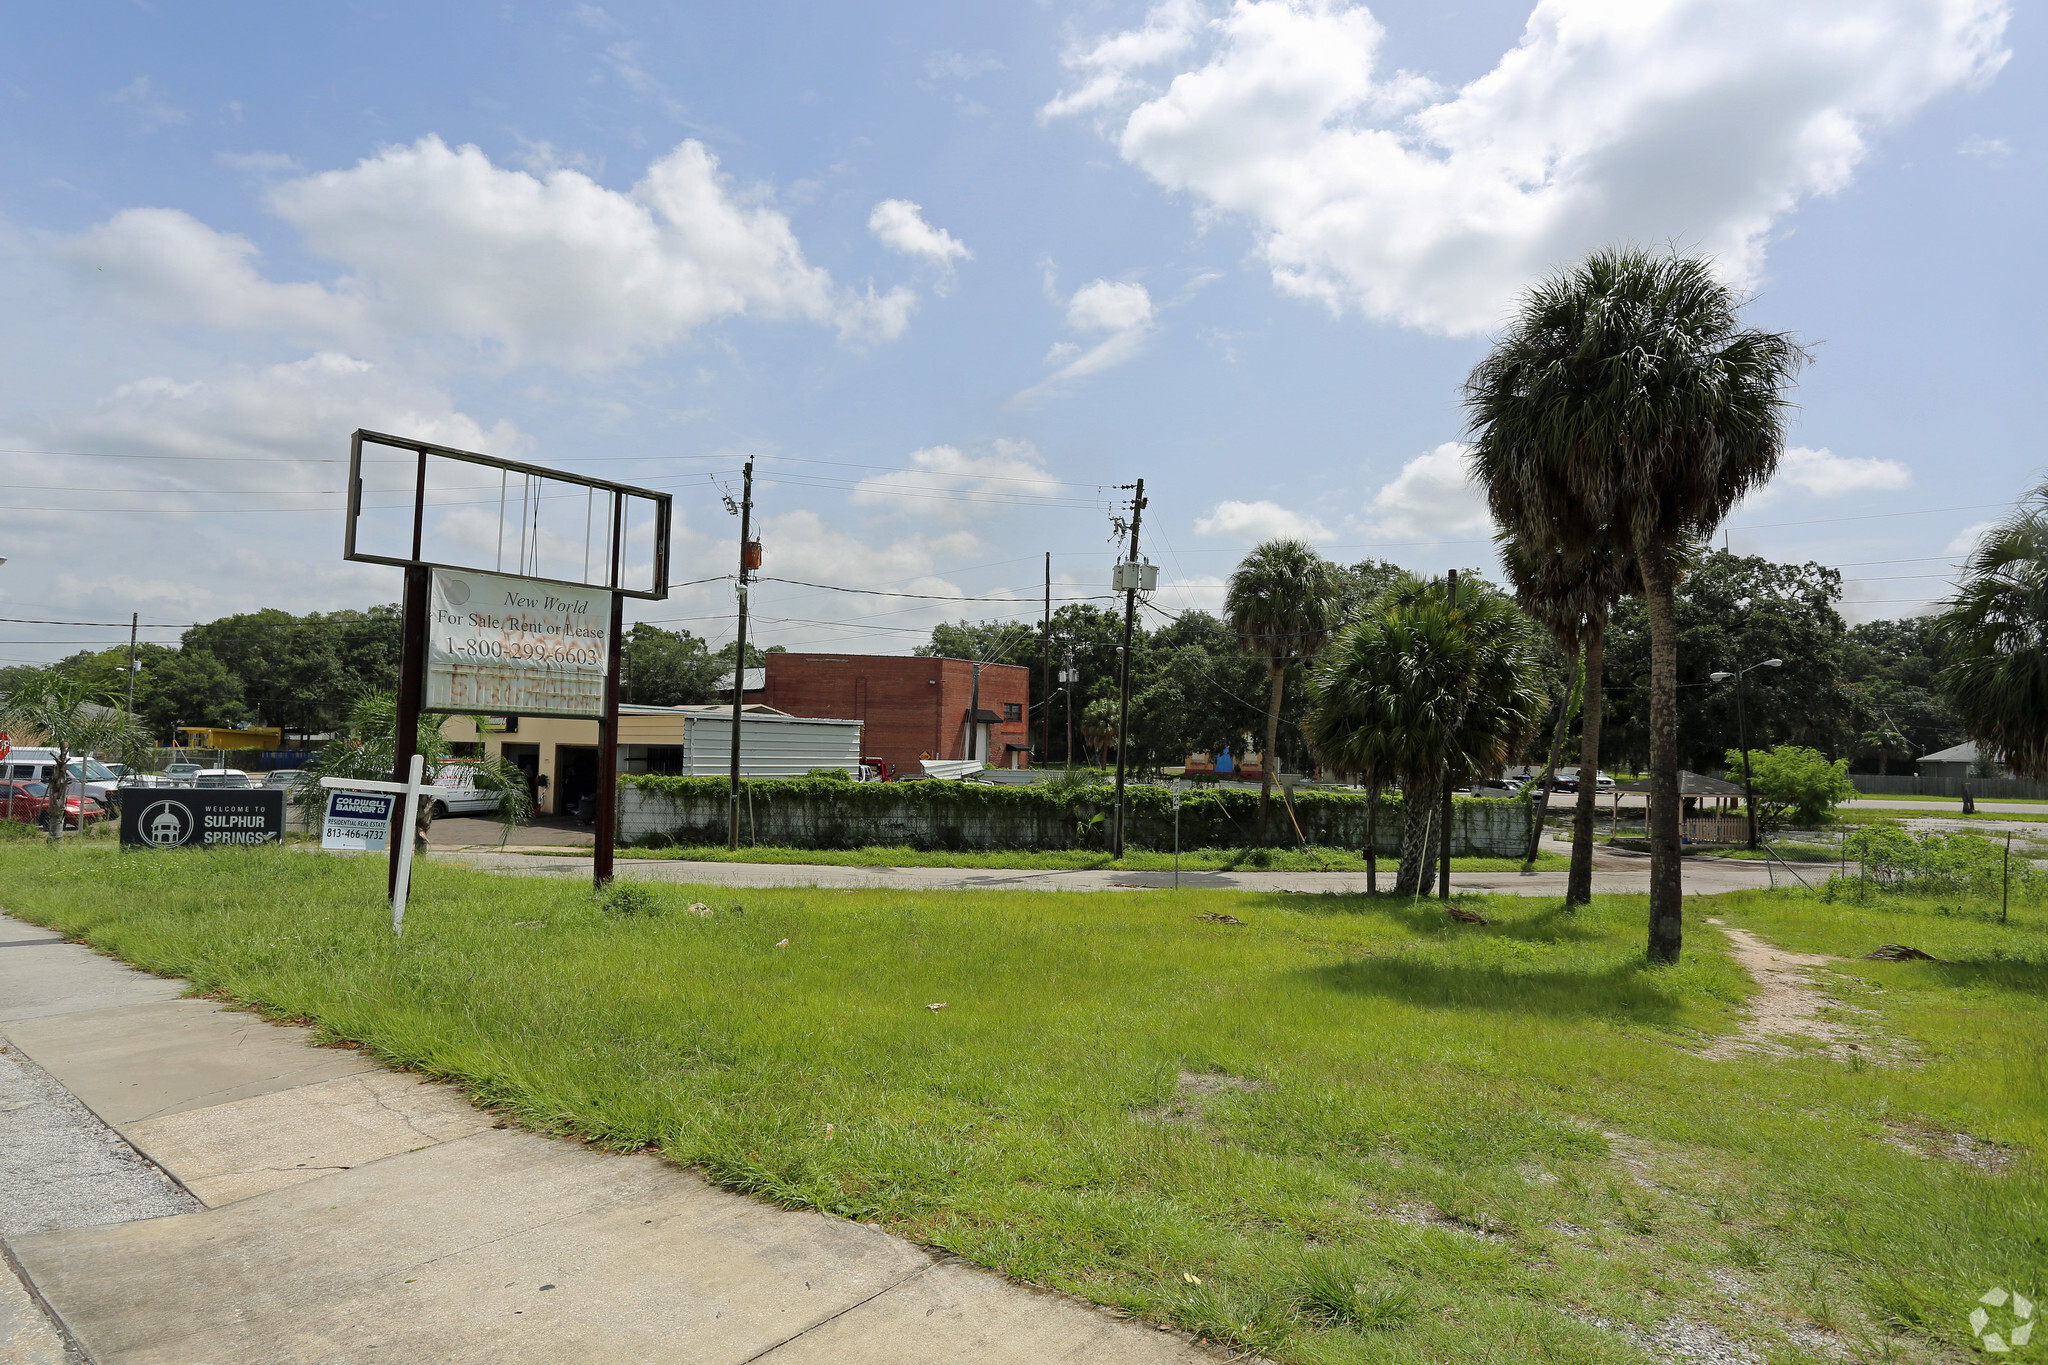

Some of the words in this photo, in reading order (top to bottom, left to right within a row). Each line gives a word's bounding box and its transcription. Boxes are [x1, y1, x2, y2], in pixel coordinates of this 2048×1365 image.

[504, 592, 538, 609] New
[544, 597, 589, 615] World
[438, 609, 463, 625] For
[469, 613, 503, 631] Sale,
[510, 618, 542, 634] Rent
[547, 624, 562, 635] or
[565, 624, 605, 639] Lease
[447, 637, 597, 665] 1-800-299-6603
[204, 816, 265, 828] SULPHUR
[328, 819, 357, 827] RESIDENTIAL
[204, 831, 264, 844] SPRINGS
[327, 828, 384, 840] 813-466-4732
